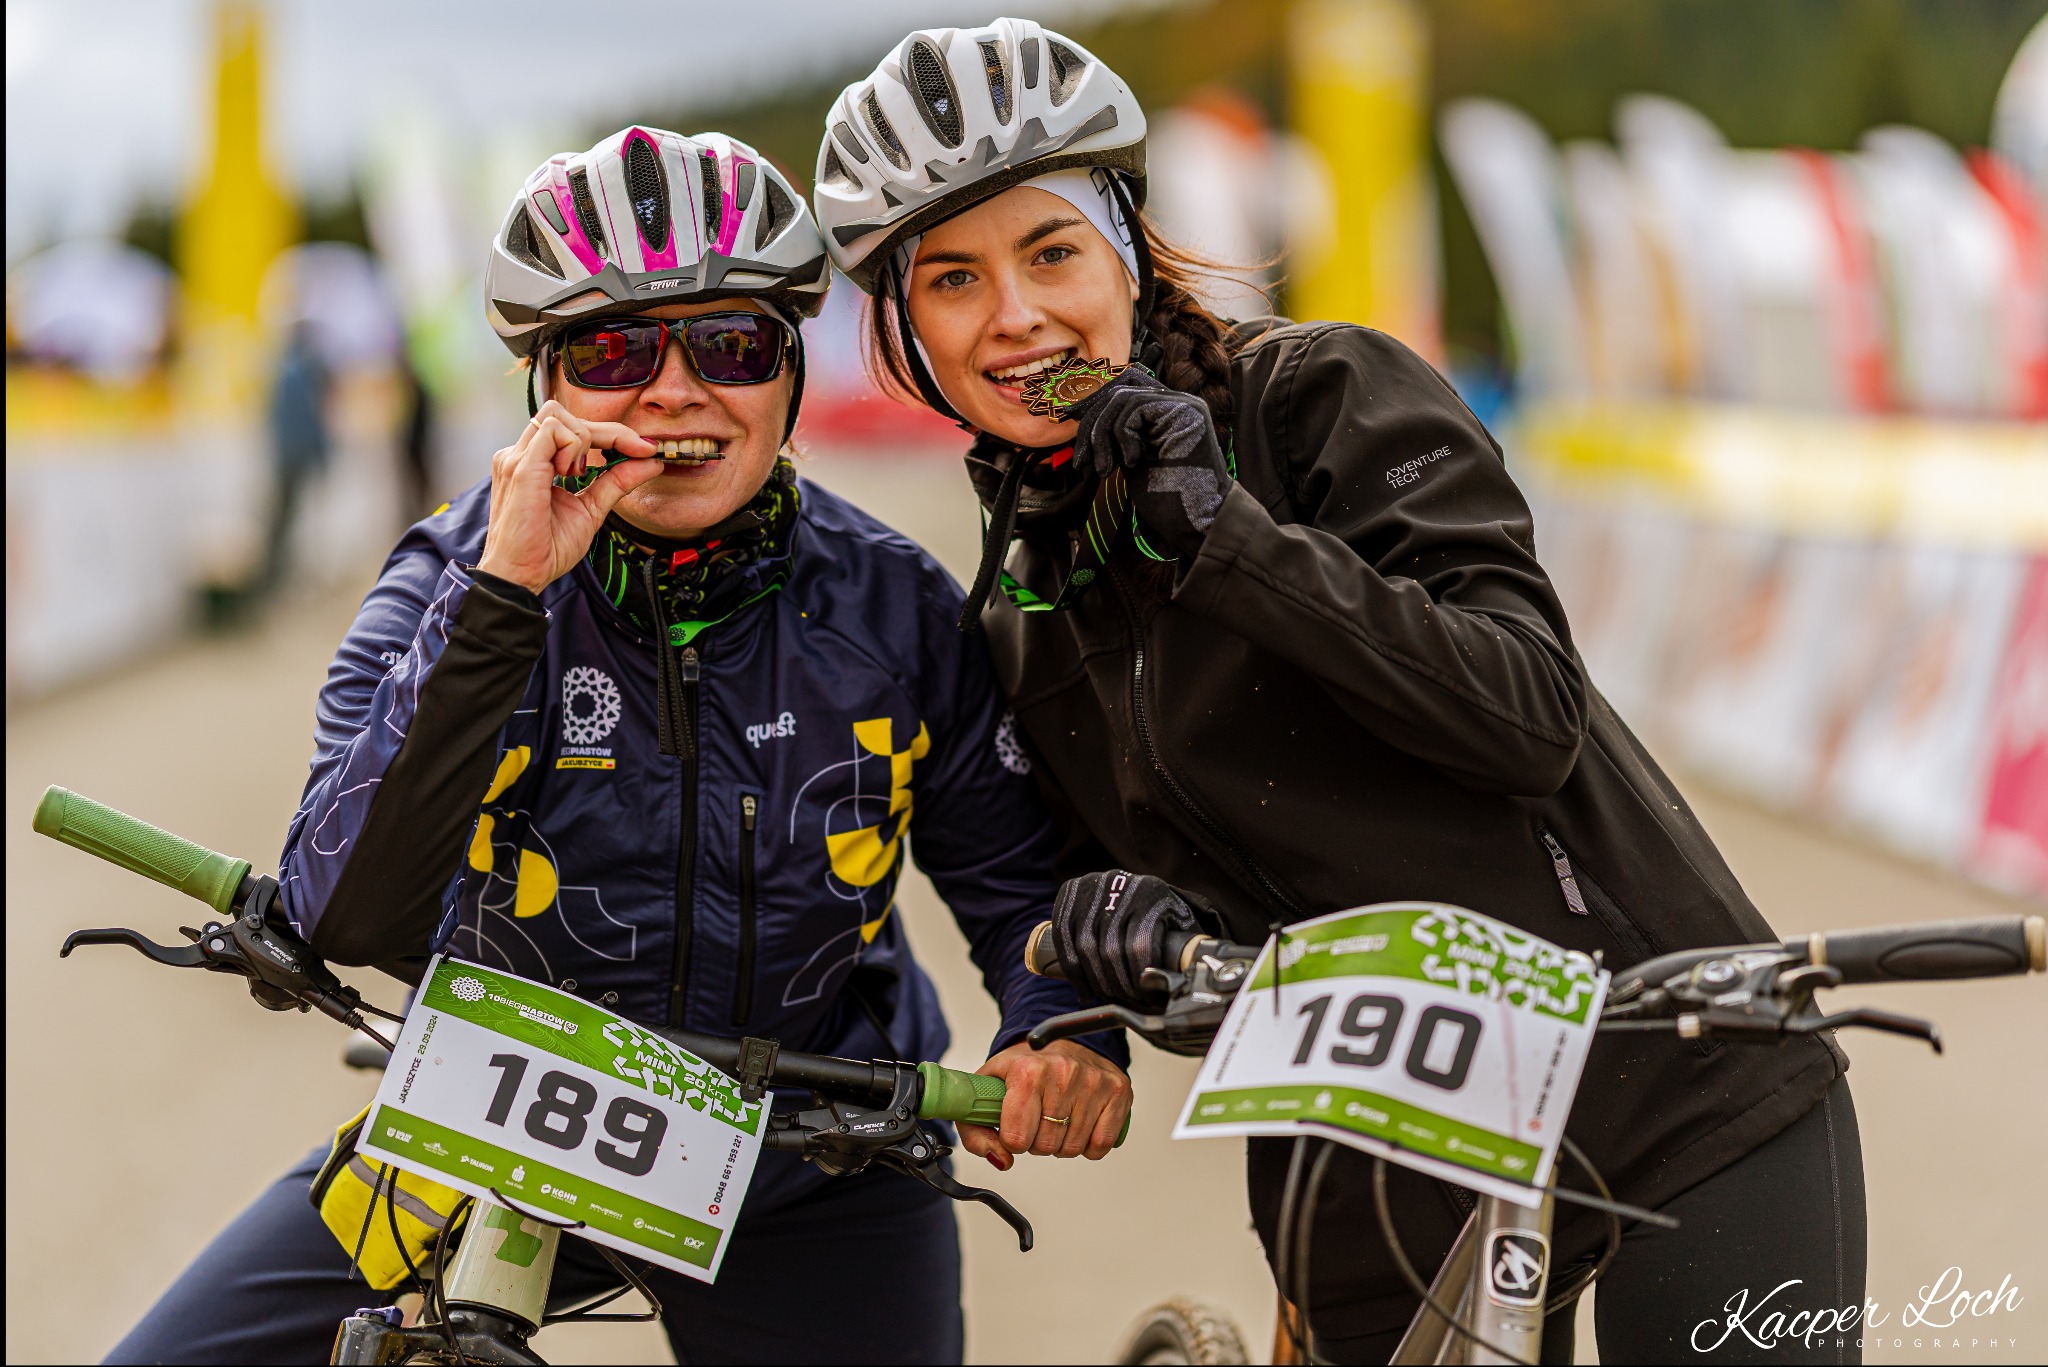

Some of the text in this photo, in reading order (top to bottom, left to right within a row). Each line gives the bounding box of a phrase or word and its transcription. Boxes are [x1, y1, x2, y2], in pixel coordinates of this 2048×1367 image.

[650, 280, 679, 290] crivit
[1386, 445, 1452, 481] ADVENTURE
[1388, 470, 1421, 489] TECH
[417, 1014, 439, 1056] 29.09.2024
[1293, 994, 1482, 1091] 190
[635, 1050, 729, 1103] MINI 20 km
[485, 1053, 669, 1177] 189
[713, 1134, 743, 1204] 0048 661 959 221
